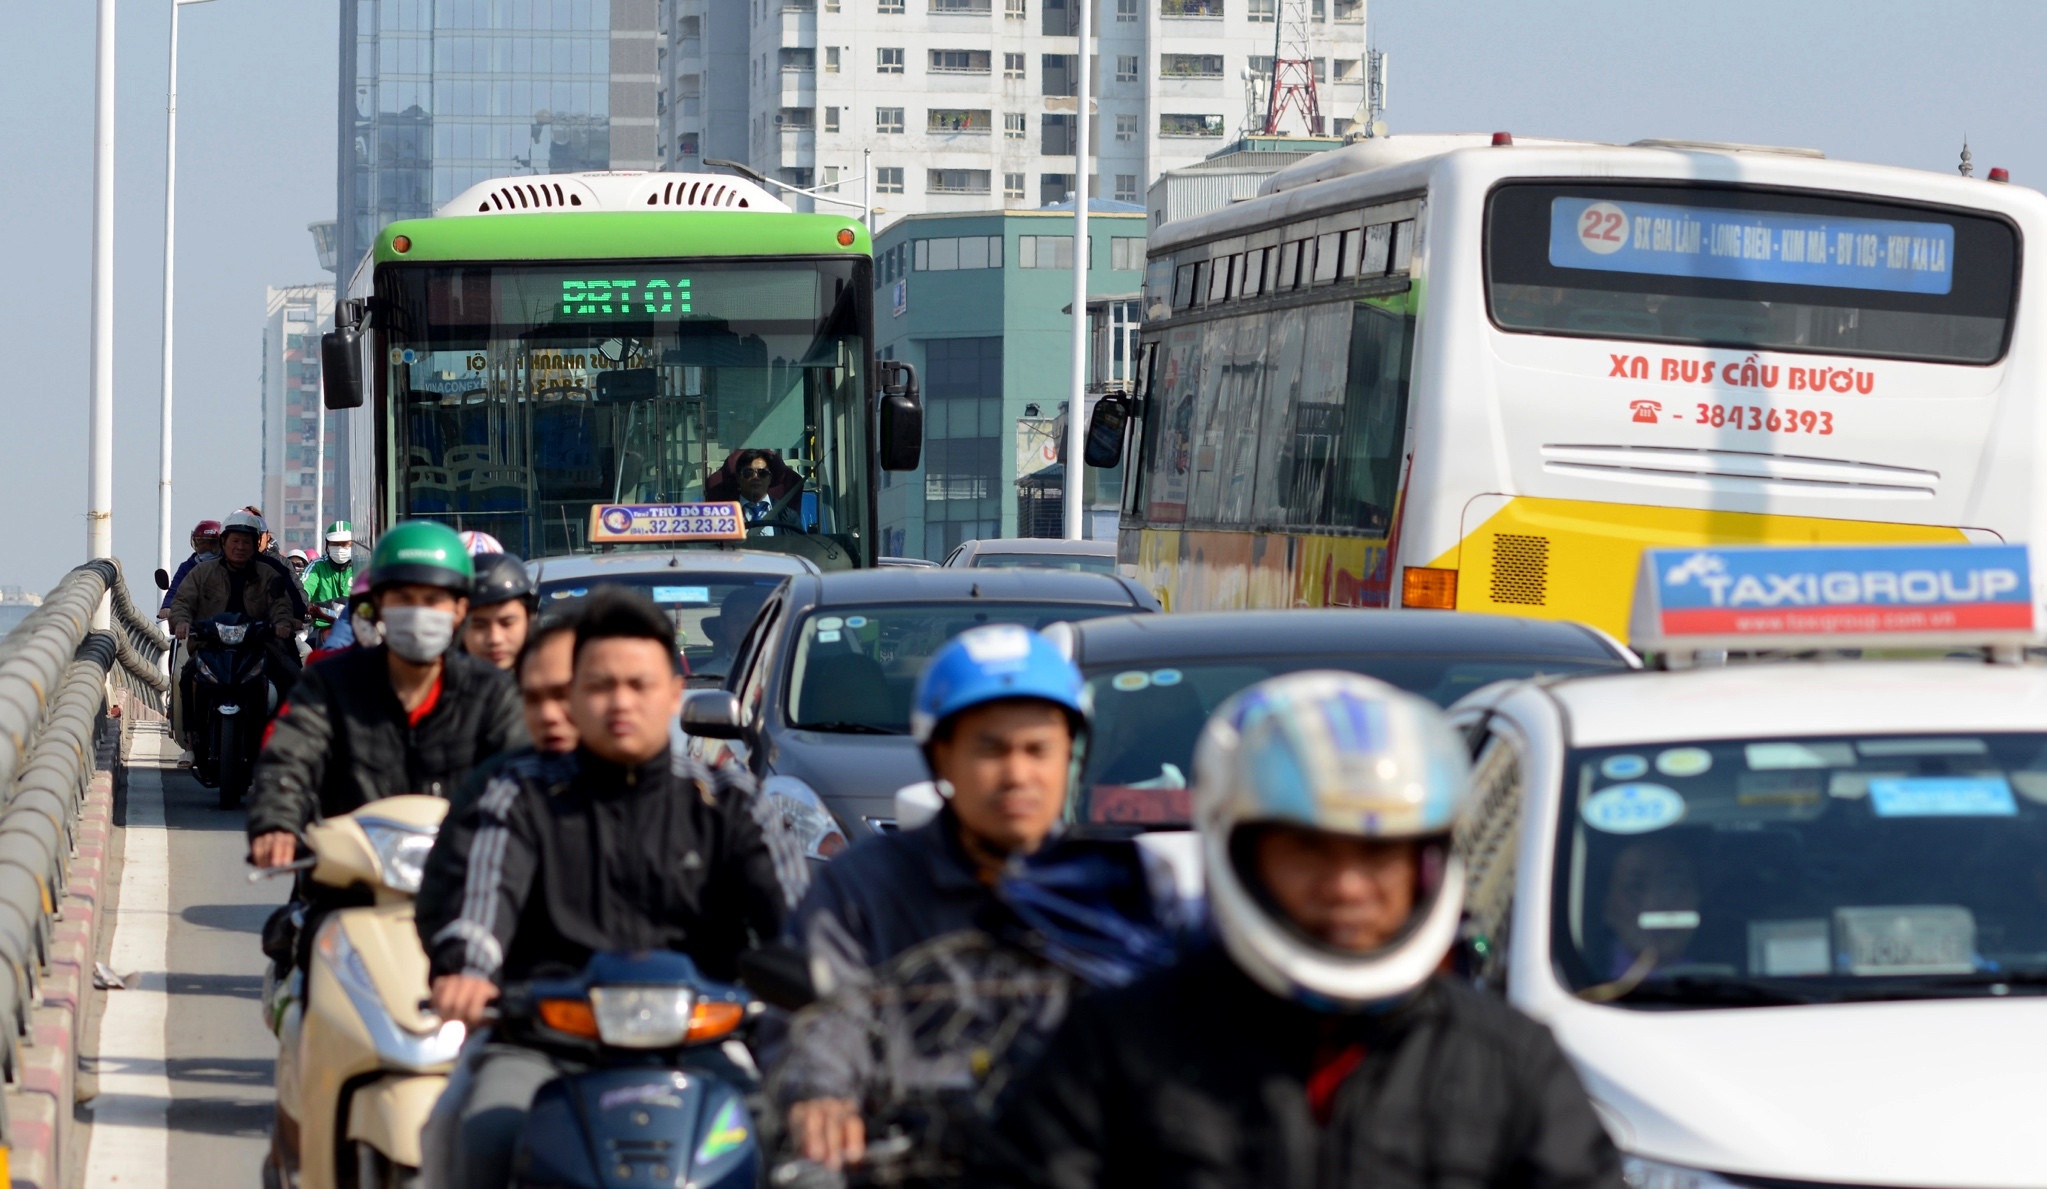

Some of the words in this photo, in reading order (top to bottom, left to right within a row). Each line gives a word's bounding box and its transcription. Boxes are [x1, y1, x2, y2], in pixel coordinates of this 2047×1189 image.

[1582, 209, 1623, 242] 22
[1634, 215, 1651, 250] BX
[1653, 216, 1672, 251] GIA
[1675, 213, 1701, 254] LÂM
[1711, 223, 1741, 258] LONG
[1743, 220, 1772, 260] BIÊN
[1781, 229, 1805, 262] KIM
[1837, 232, 1854, 266] BV
[1856, 233, 1878, 268] 103
[1911, 236, 1928, 271] XA
[1930, 237, 1945, 272] LA
[562, 280, 637, 314] BRT
[644, 278, 691, 313] 01
[1609, 354, 1649, 379] XN
[1661, 357, 1716, 384] BUS
[1722, 353, 1779, 389] CẦU
[1788, 365, 1874, 395] BƯƠU
[1696, 403, 1834, 435] 38436393
[649, 505, 678, 517] THỦ
[681, 505, 700, 517] ĐÔ
[703, 506, 731, 517] SAO
[1700, 568, 2018, 607] TAXIGROUP
